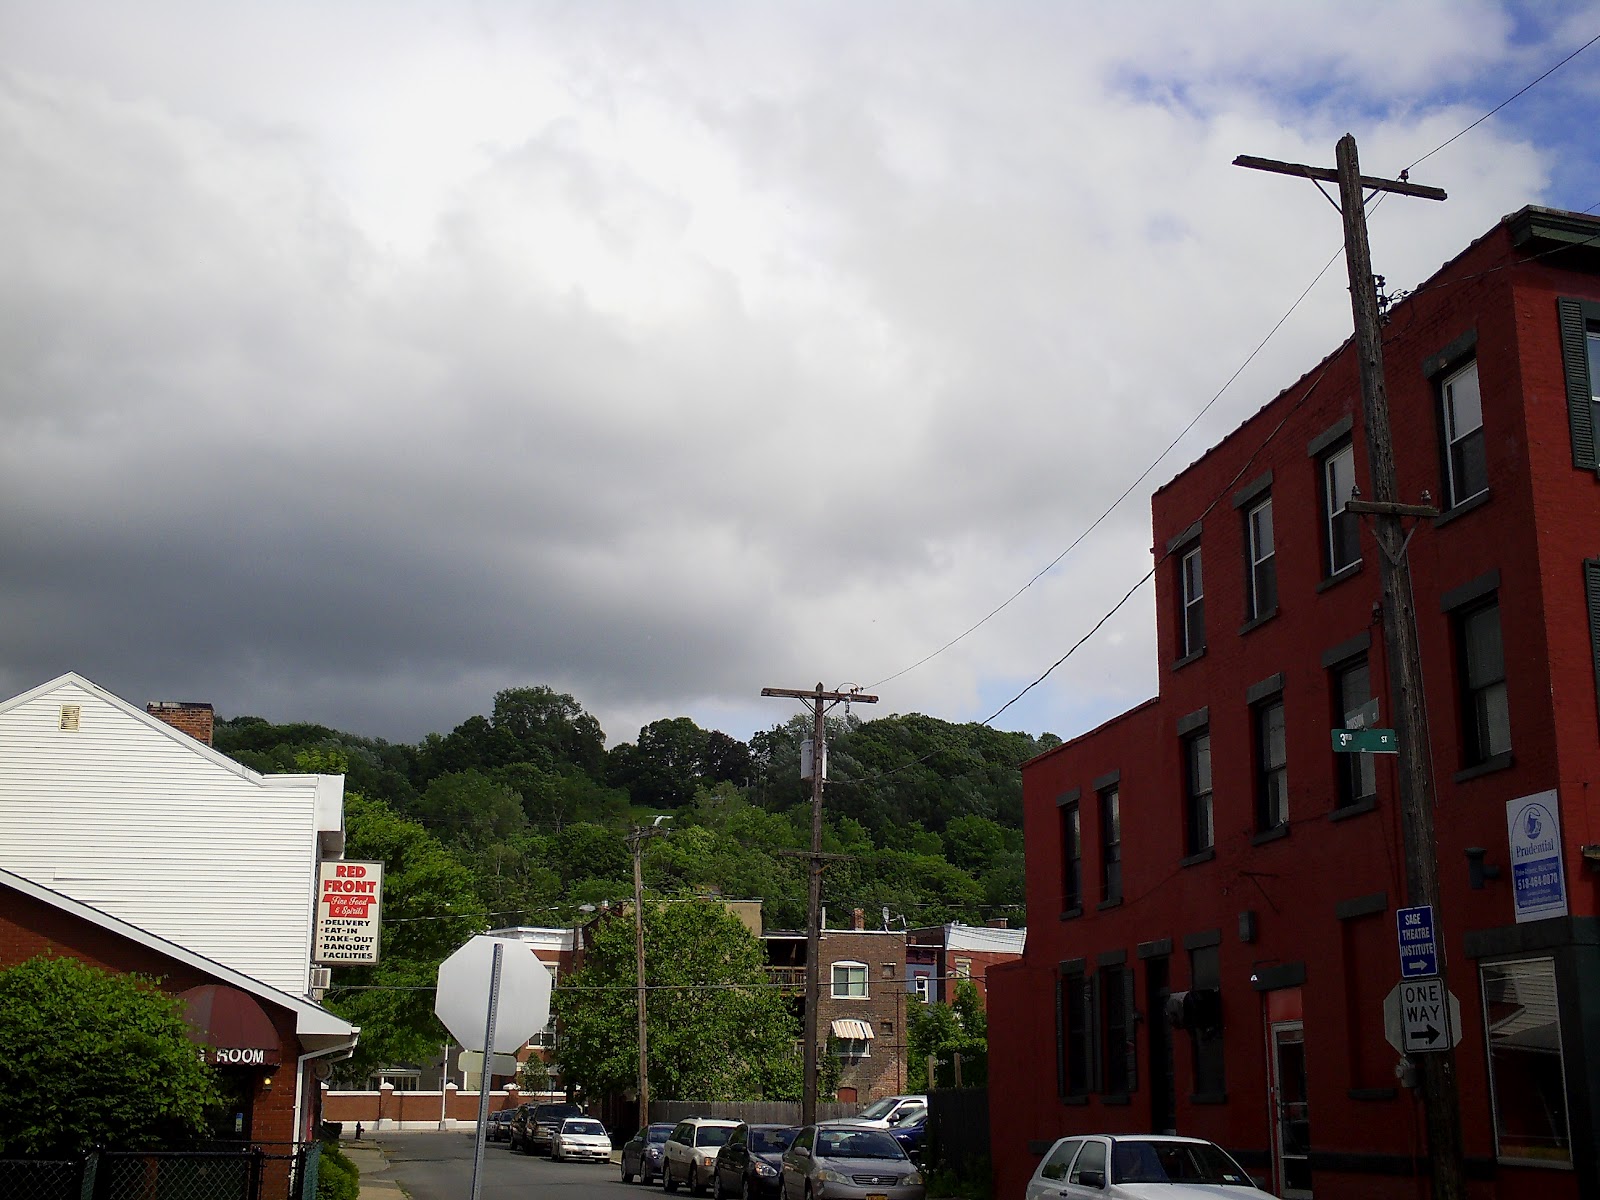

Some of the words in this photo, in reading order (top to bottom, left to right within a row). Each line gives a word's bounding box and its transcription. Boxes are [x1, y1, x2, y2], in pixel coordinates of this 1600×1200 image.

[1381, 735, 1388, 743] ST
[1516, 838, 1554, 858] Prudential
[336, 865, 367, 878] RED
[323, 880, 377, 893] FRONT
[331, 896, 347, 905] Fine
[349, 896, 368, 905] Food
[341, 906, 364, 917] Spirits
[1405, 913, 1422, 925] SAGE
[1402, 927, 1431, 941] THEATRE
[1401, 943, 1434, 957] INSTITUTE
[1405, 986, 1439, 1004] ONE
[1407, 1005, 1440, 1022] WAY
[217, 1049, 264, 1063] ROOM
